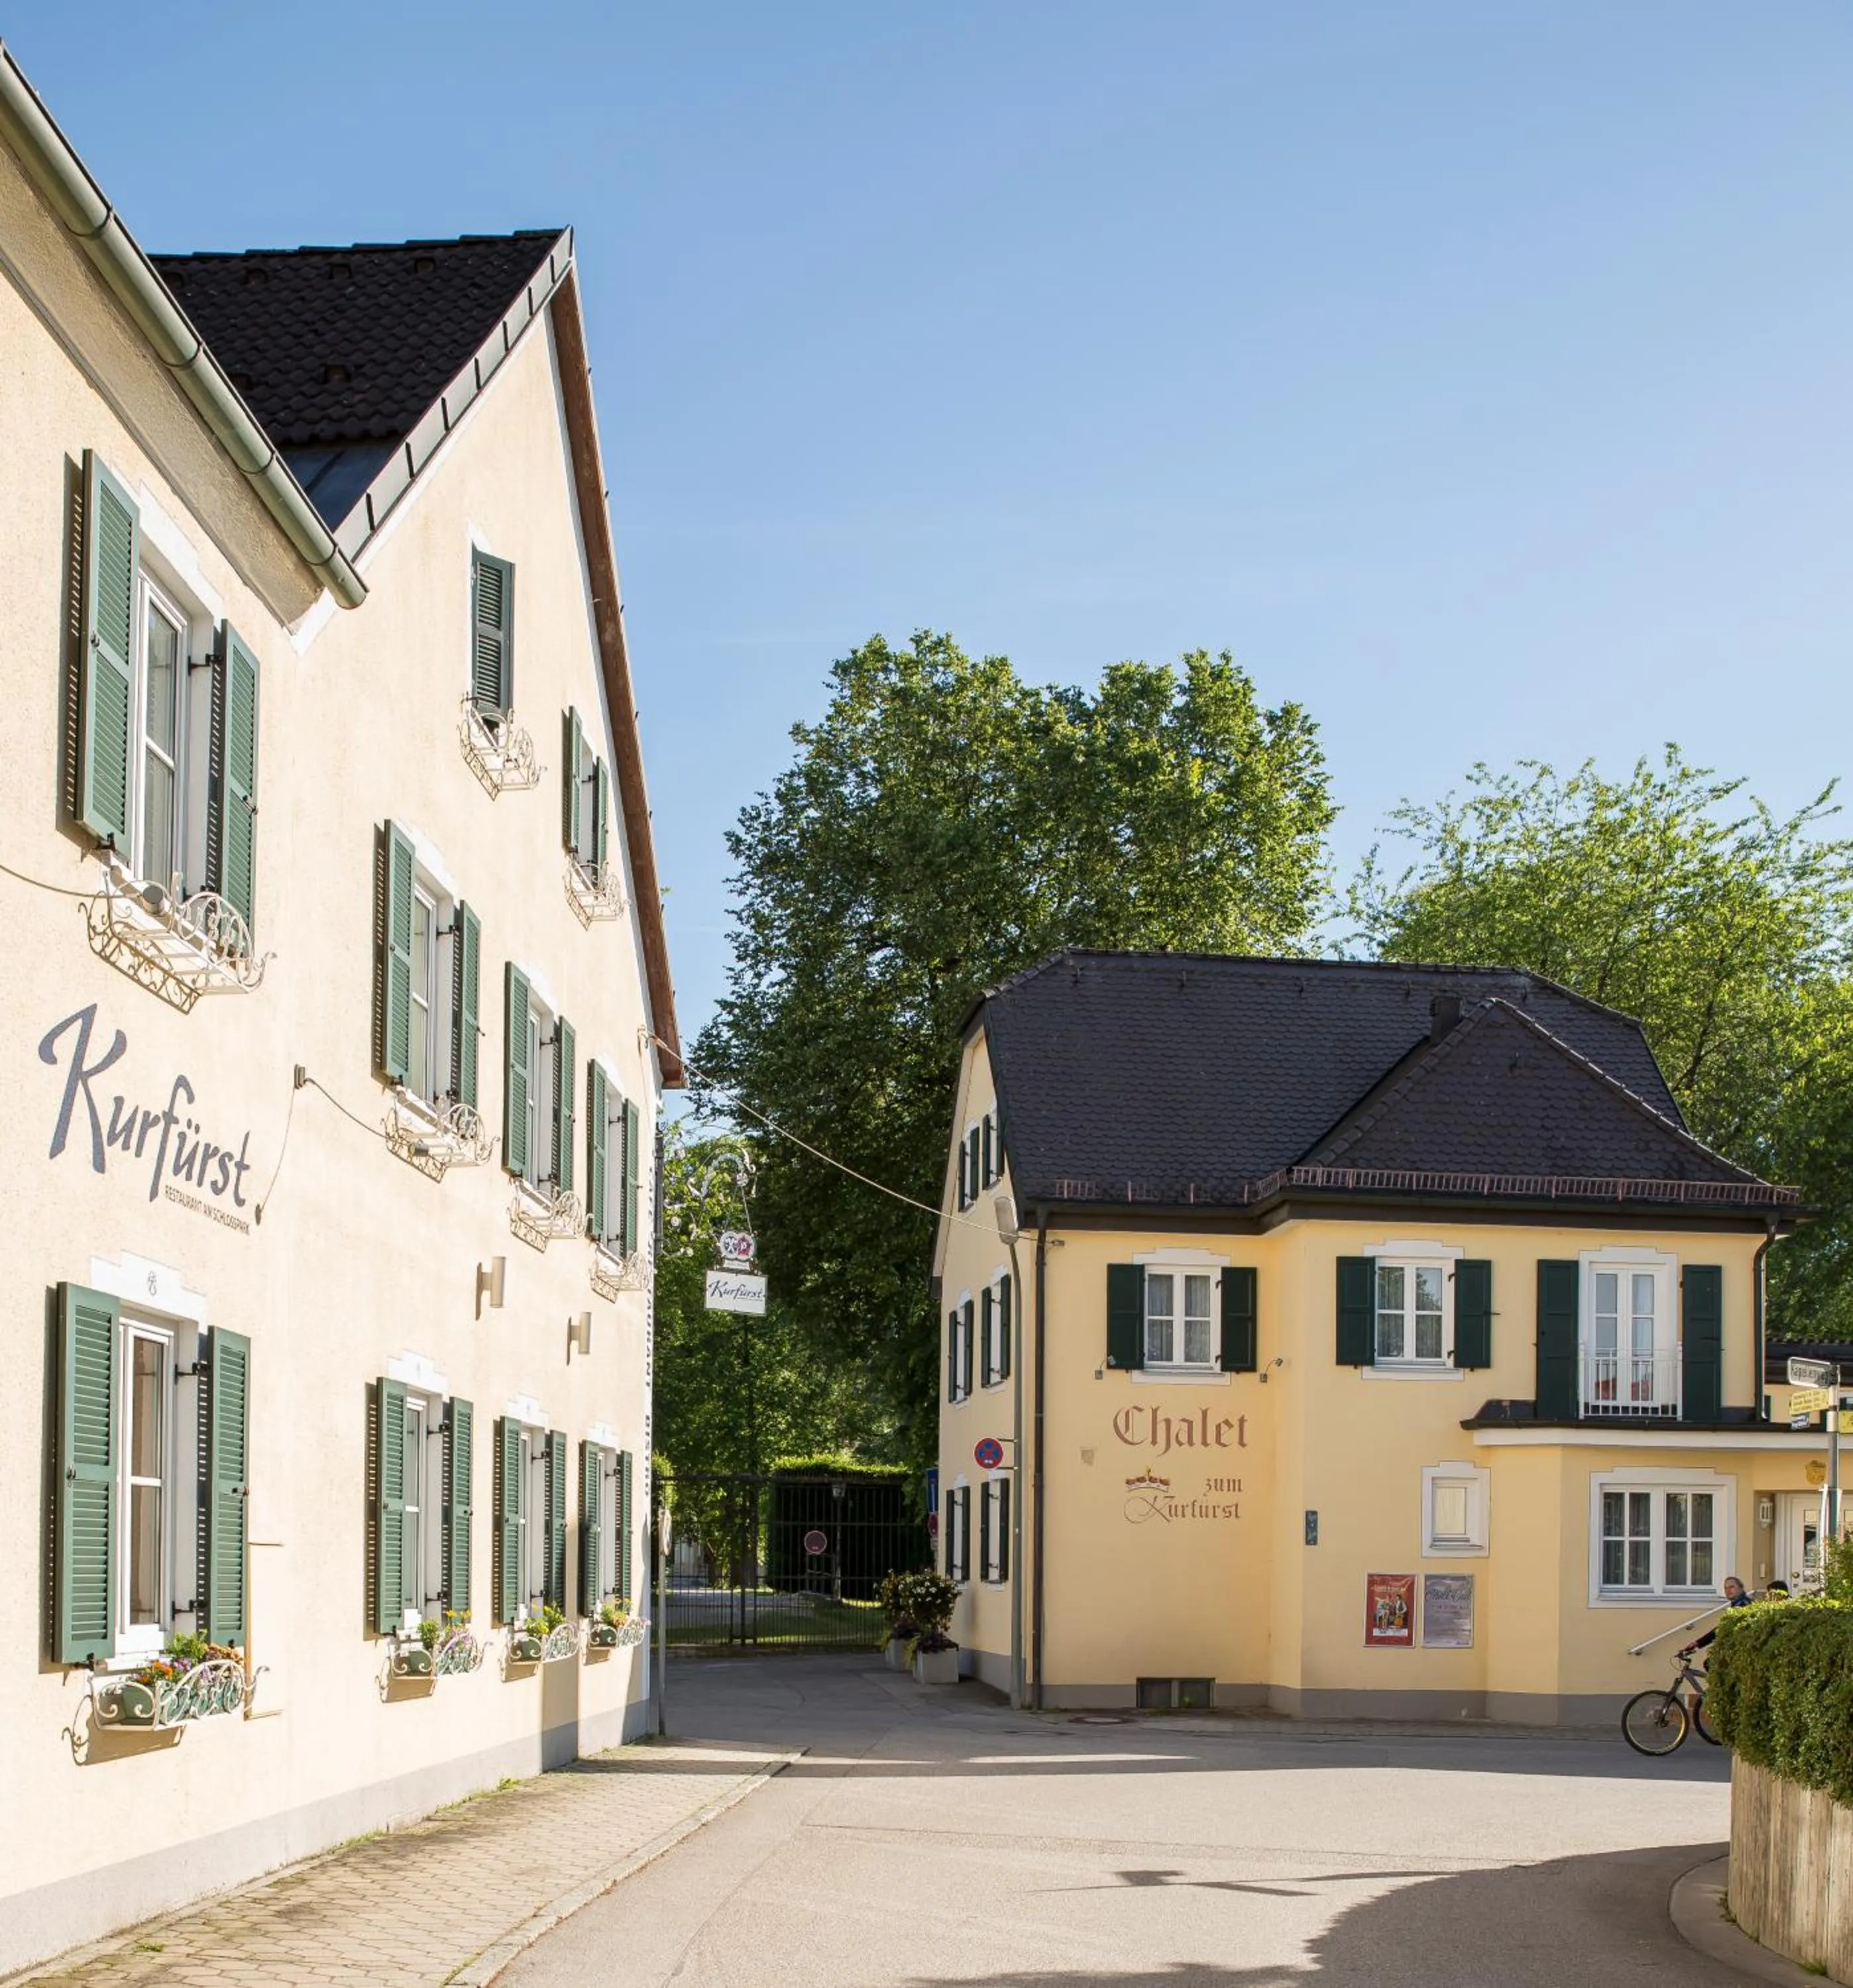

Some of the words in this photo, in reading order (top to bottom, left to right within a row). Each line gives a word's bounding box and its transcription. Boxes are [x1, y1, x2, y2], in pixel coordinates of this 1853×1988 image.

[38, 1003, 251, 1207] Kurfürst
[1113, 1405, 1249, 1459] Chalet
[1203, 1478, 1243, 1496] zum
[1123, 1496, 1241, 1524] Kurfürst
